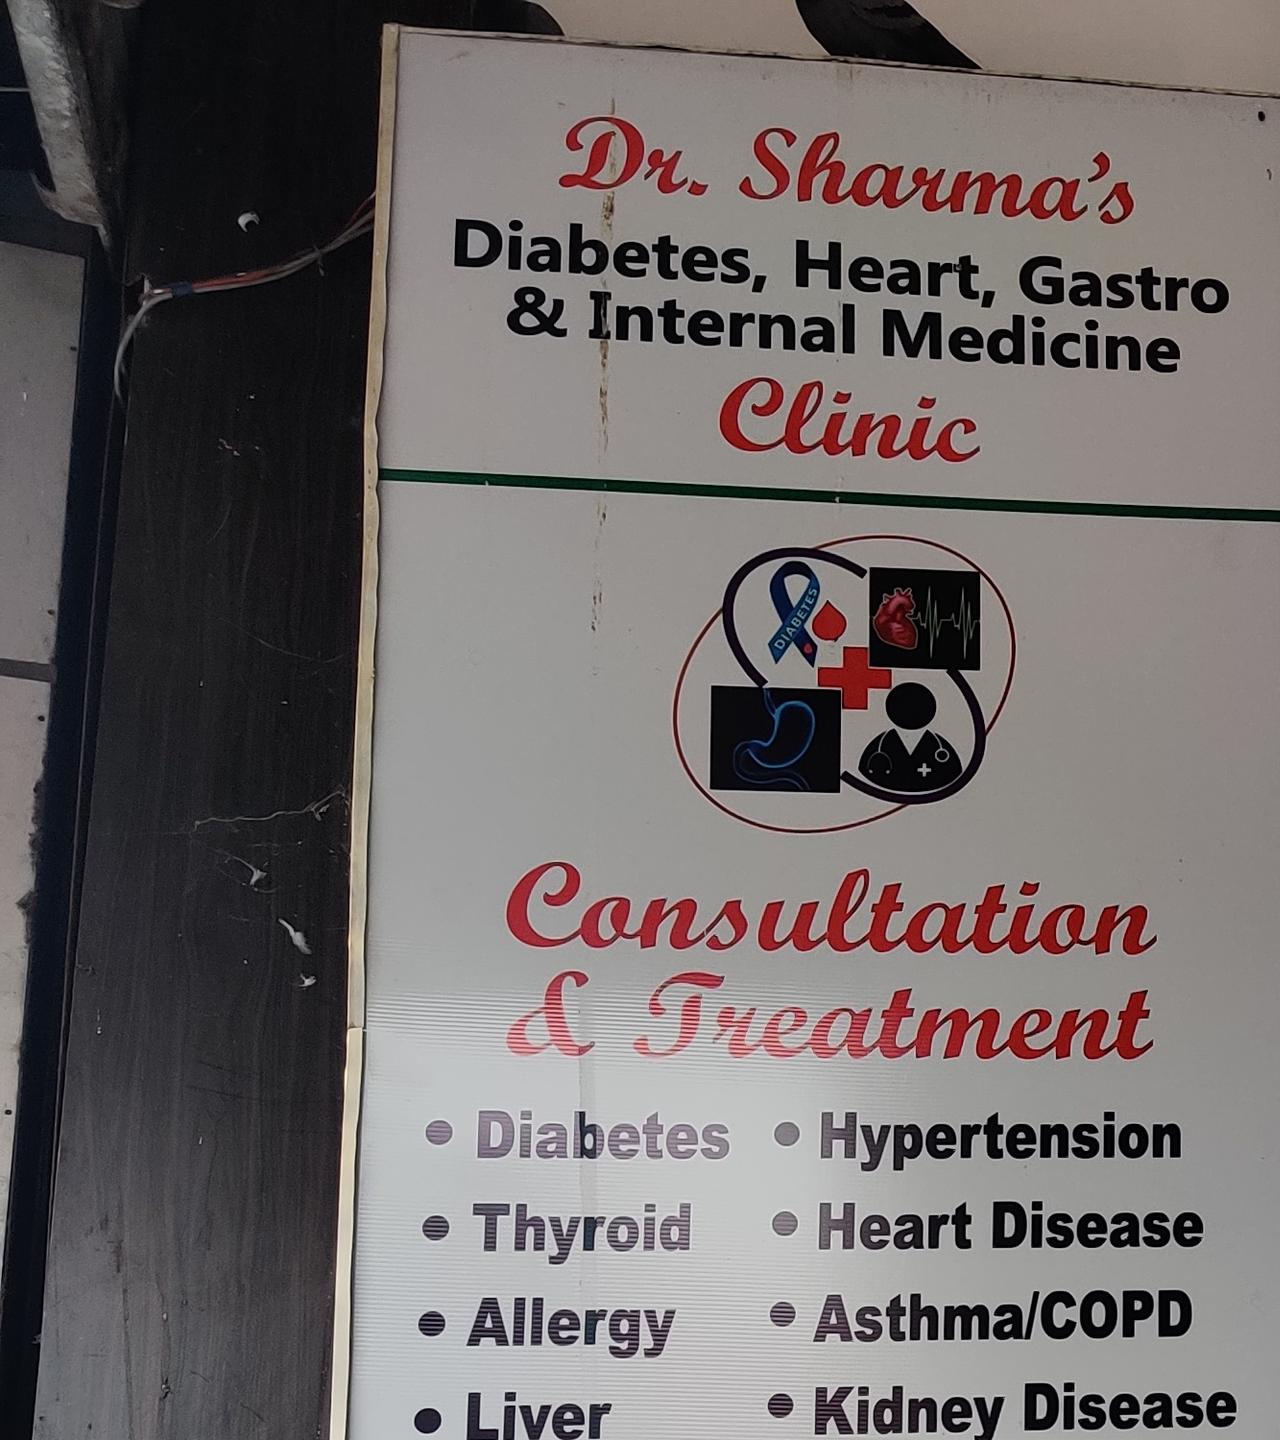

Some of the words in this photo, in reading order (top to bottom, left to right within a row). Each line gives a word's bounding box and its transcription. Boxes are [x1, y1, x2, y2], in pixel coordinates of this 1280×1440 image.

[558, 115, 707, 197] Dr.
[739, 127, 1135, 224] Sharma's
[453, 219, 767, 294] Diabetes,
[795, 240, 996, 304] Heart,
[1019, 257, 1229, 314] Gastro
[506, 286, 568, 339] &
[588, 290, 856, 355] Internal
[882, 308, 1180, 372] Medicine
[719, 376, 981, 464] Clinic
[775, 586, 818, 650] DIABETES
[504, 861, 1156, 954] Consultation
[506, 971, 595, 1058] &
[634, 972, 1154, 1061] Treatment
[476, 1110, 730, 1161] Diabetes
[819, 1110, 1182, 1170] Hypertension
[471, 1203, 692, 1265] Thyroid
[816, 1202, 971, 1250] Heart
[991, 1200, 1205, 1249] Disease
[467, 1297, 676, 1357] Allergy
[813, 1290, 1193, 1344] Asthma/COPD
[1022, 1380, 1237, 1431] Disease
